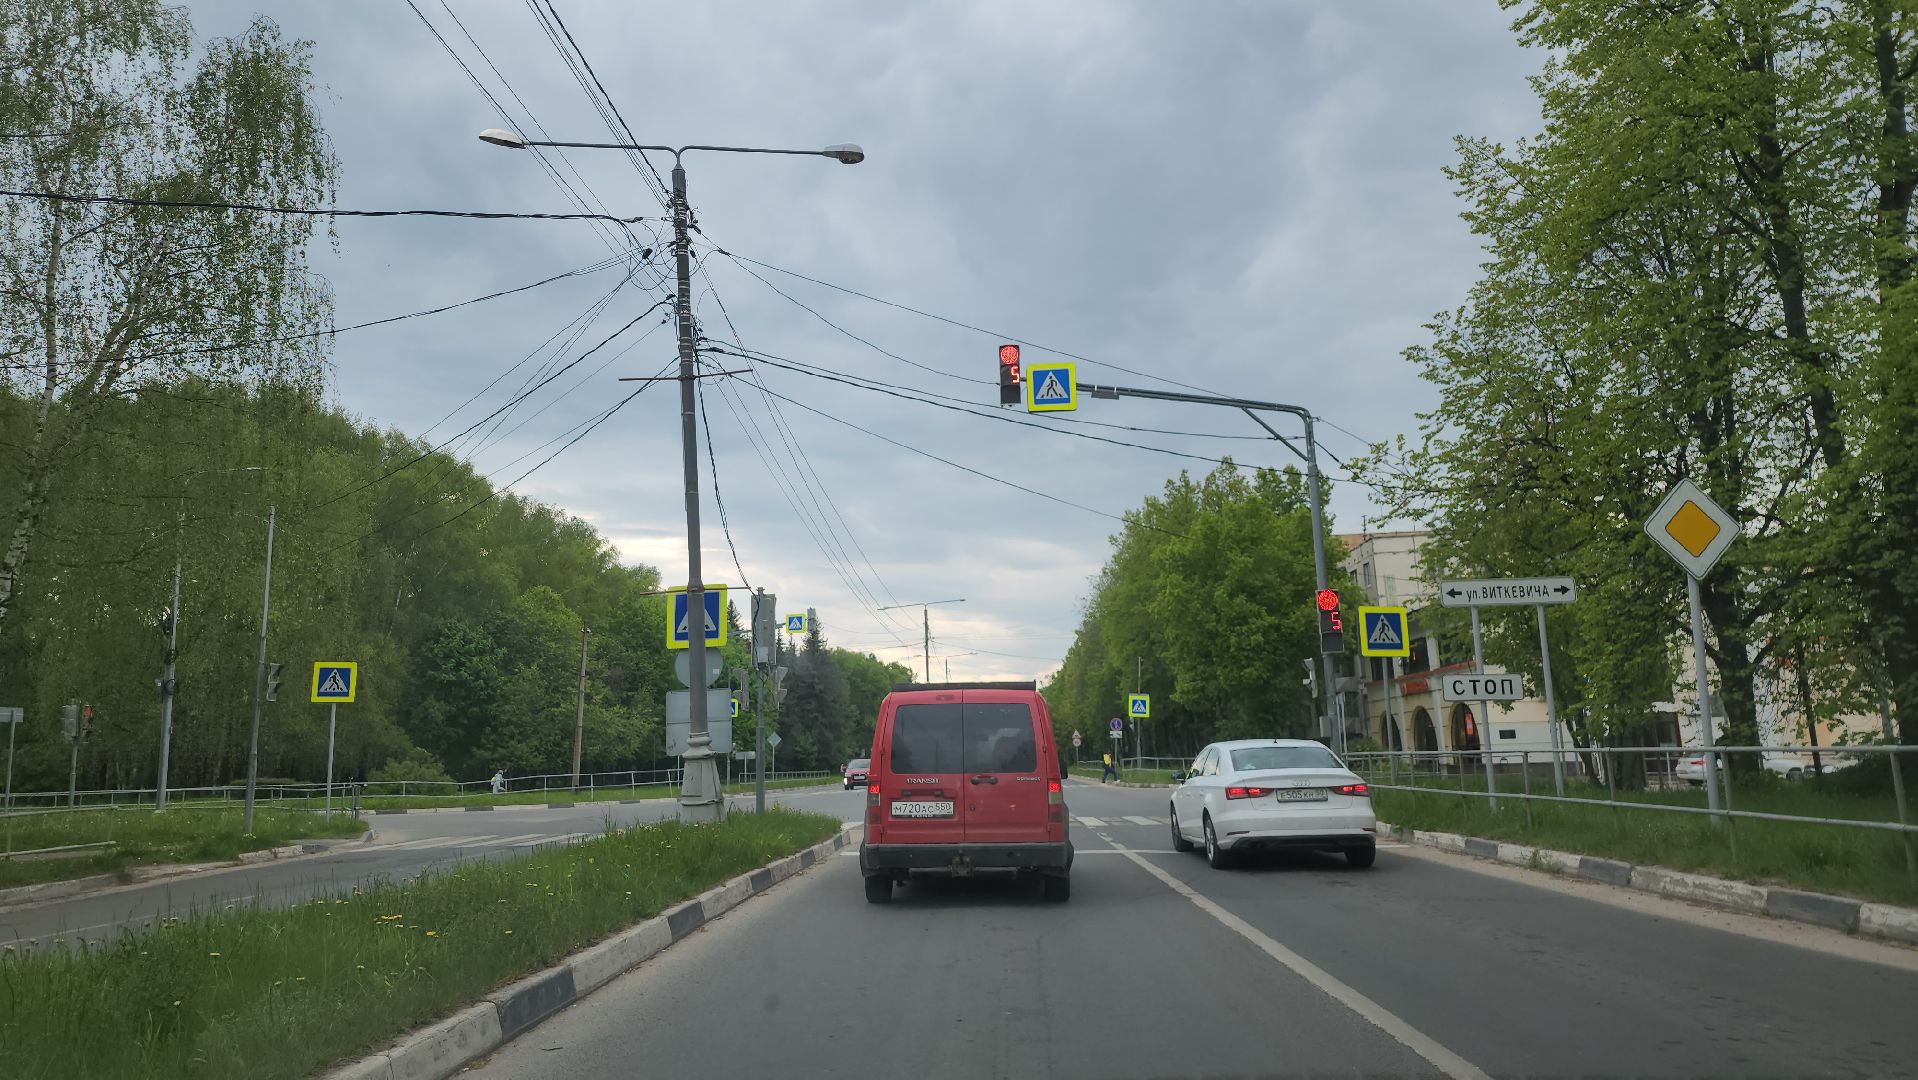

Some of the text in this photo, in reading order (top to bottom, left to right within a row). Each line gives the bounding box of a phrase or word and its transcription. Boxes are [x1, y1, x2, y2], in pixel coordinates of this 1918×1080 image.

[1011, 366, 1020, 383] 5
[1331, 611, 1342, 630] 5
[1452, 679, 1514, 696] СТОП
